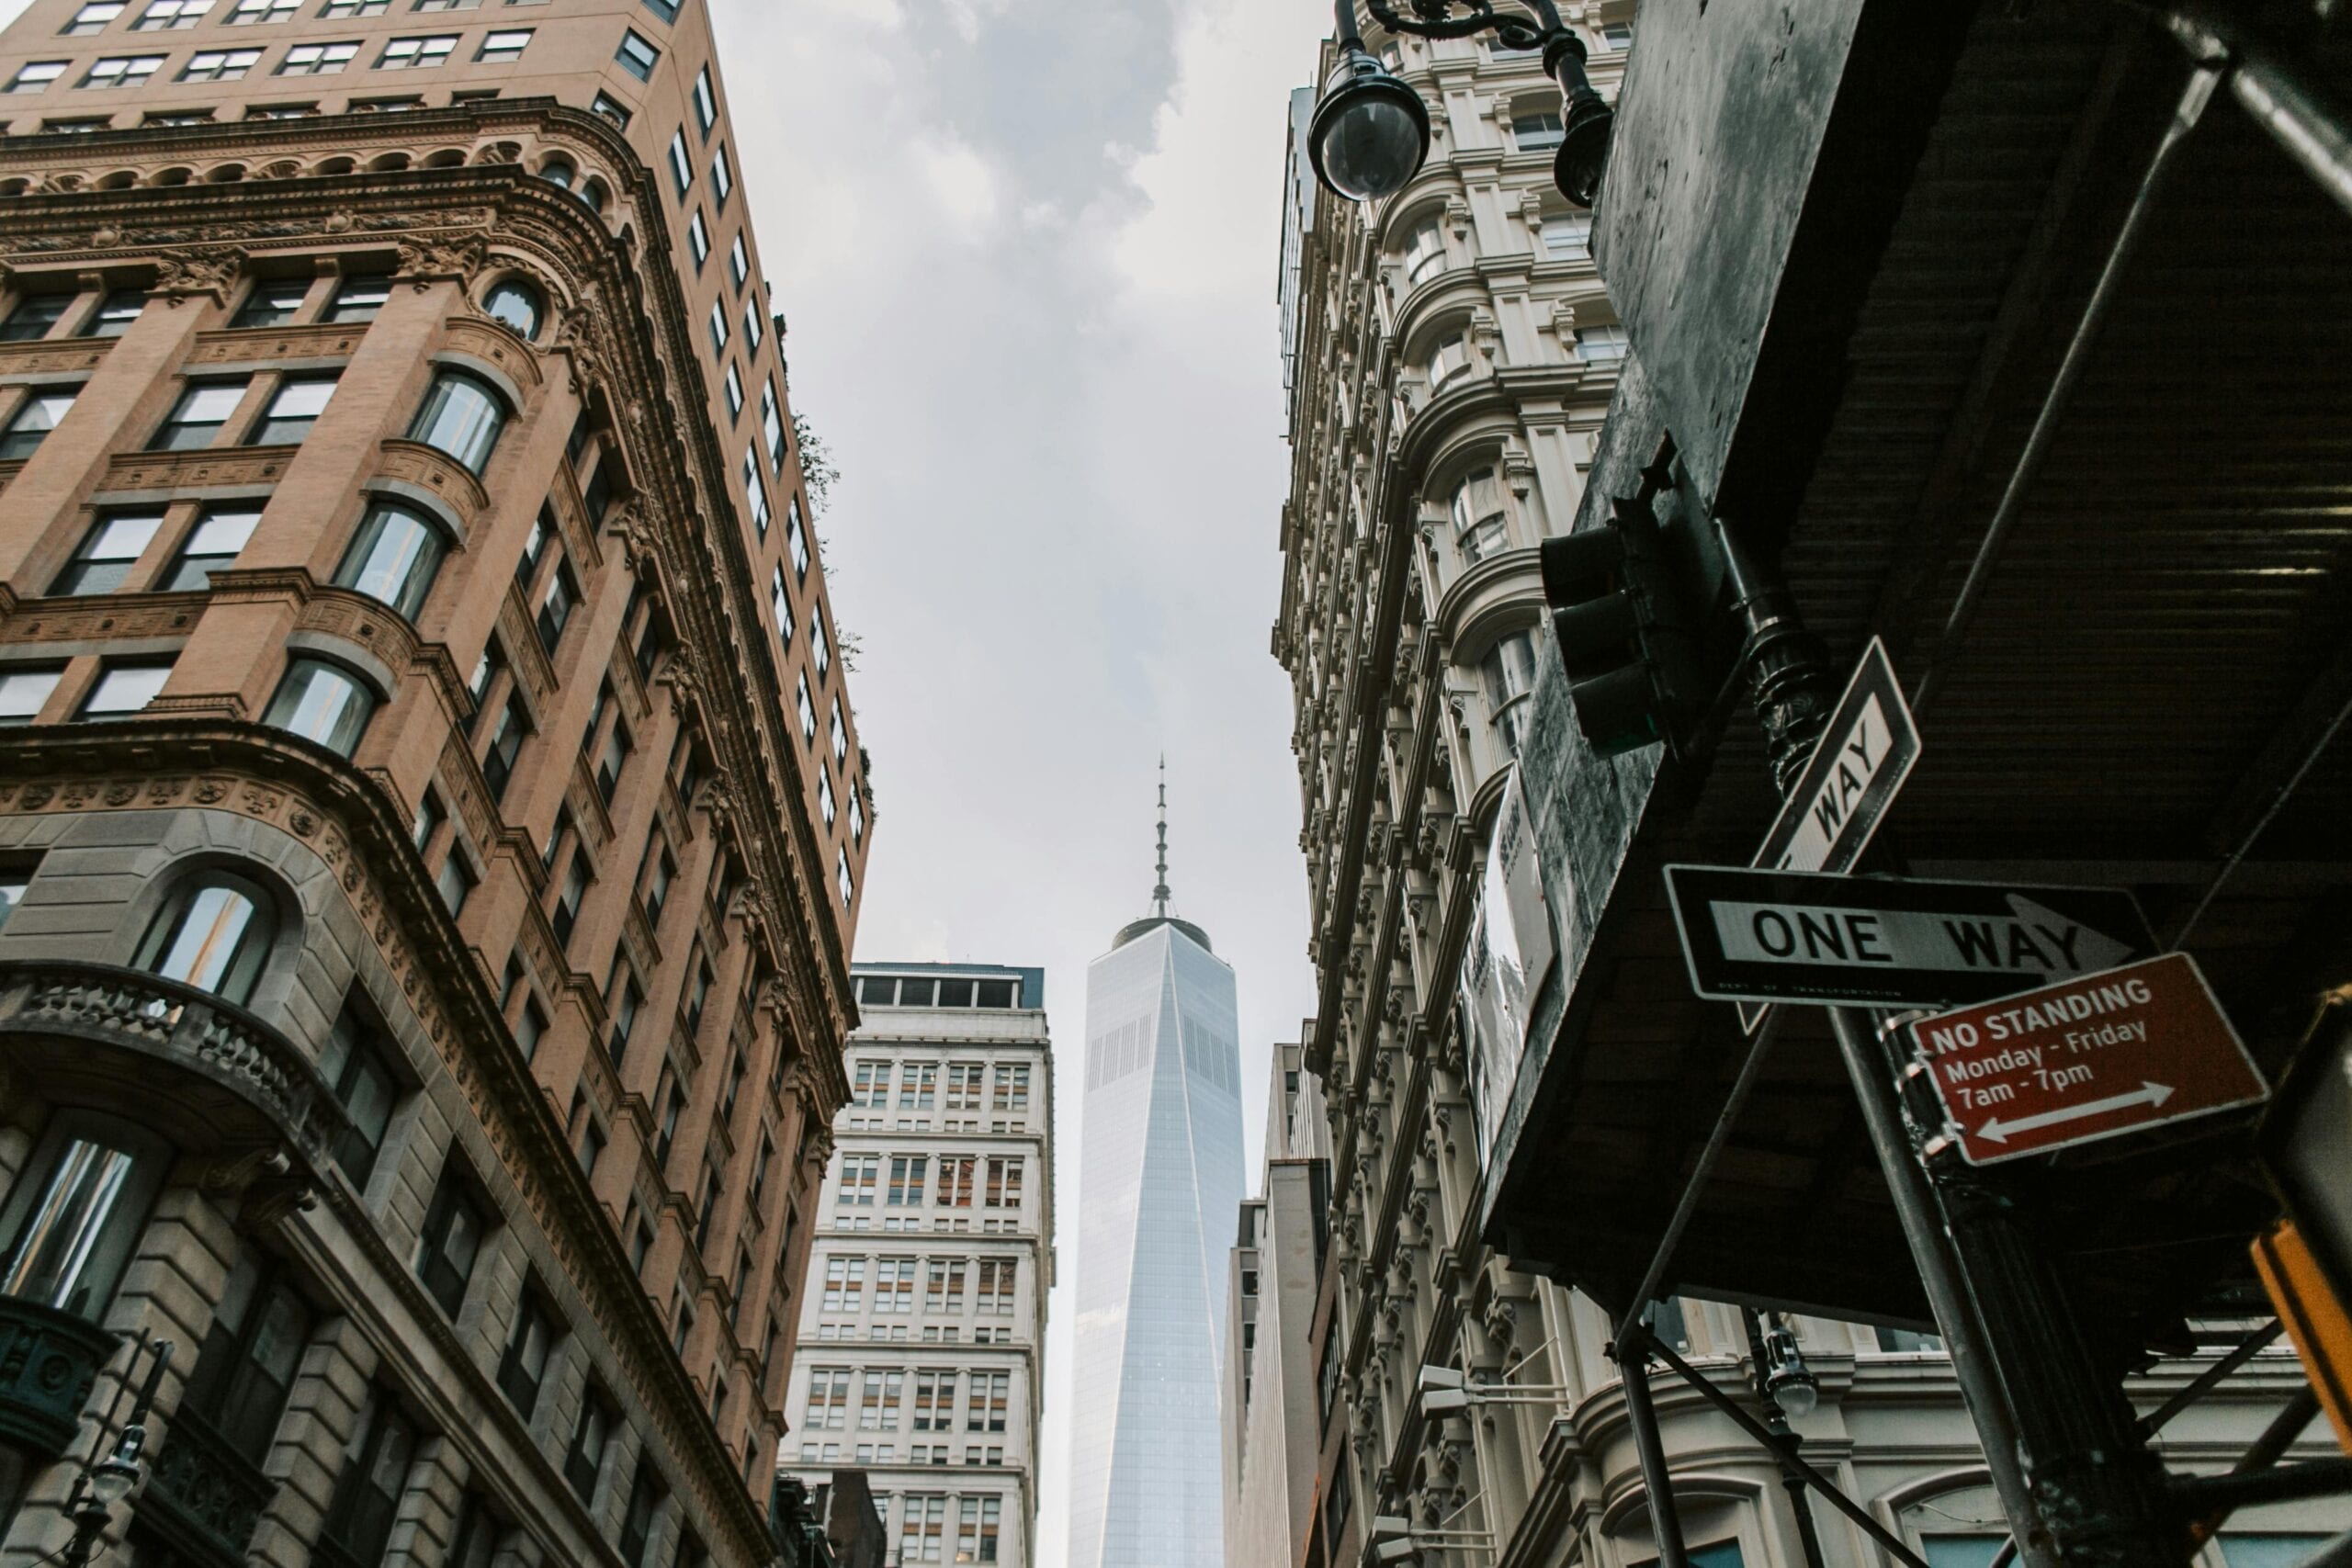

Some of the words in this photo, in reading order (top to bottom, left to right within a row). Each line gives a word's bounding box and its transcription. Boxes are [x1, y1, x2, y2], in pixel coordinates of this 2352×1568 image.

[1815, 718, 1871, 842] WAY
[1753, 909, 1894, 963] ONE
[1943, 919, 2080, 970] WAY
[1931, 1022, 1978, 1055] NO
[1985, 978, 2153, 1040] STANDING
[1944, 1043, 2041, 1084] Monday
[2066, 1019, 2147, 1055] Friday
[1957, 1079, 2015, 1110] 7am
[2033, 1062, 2094, 1093] 7pm
